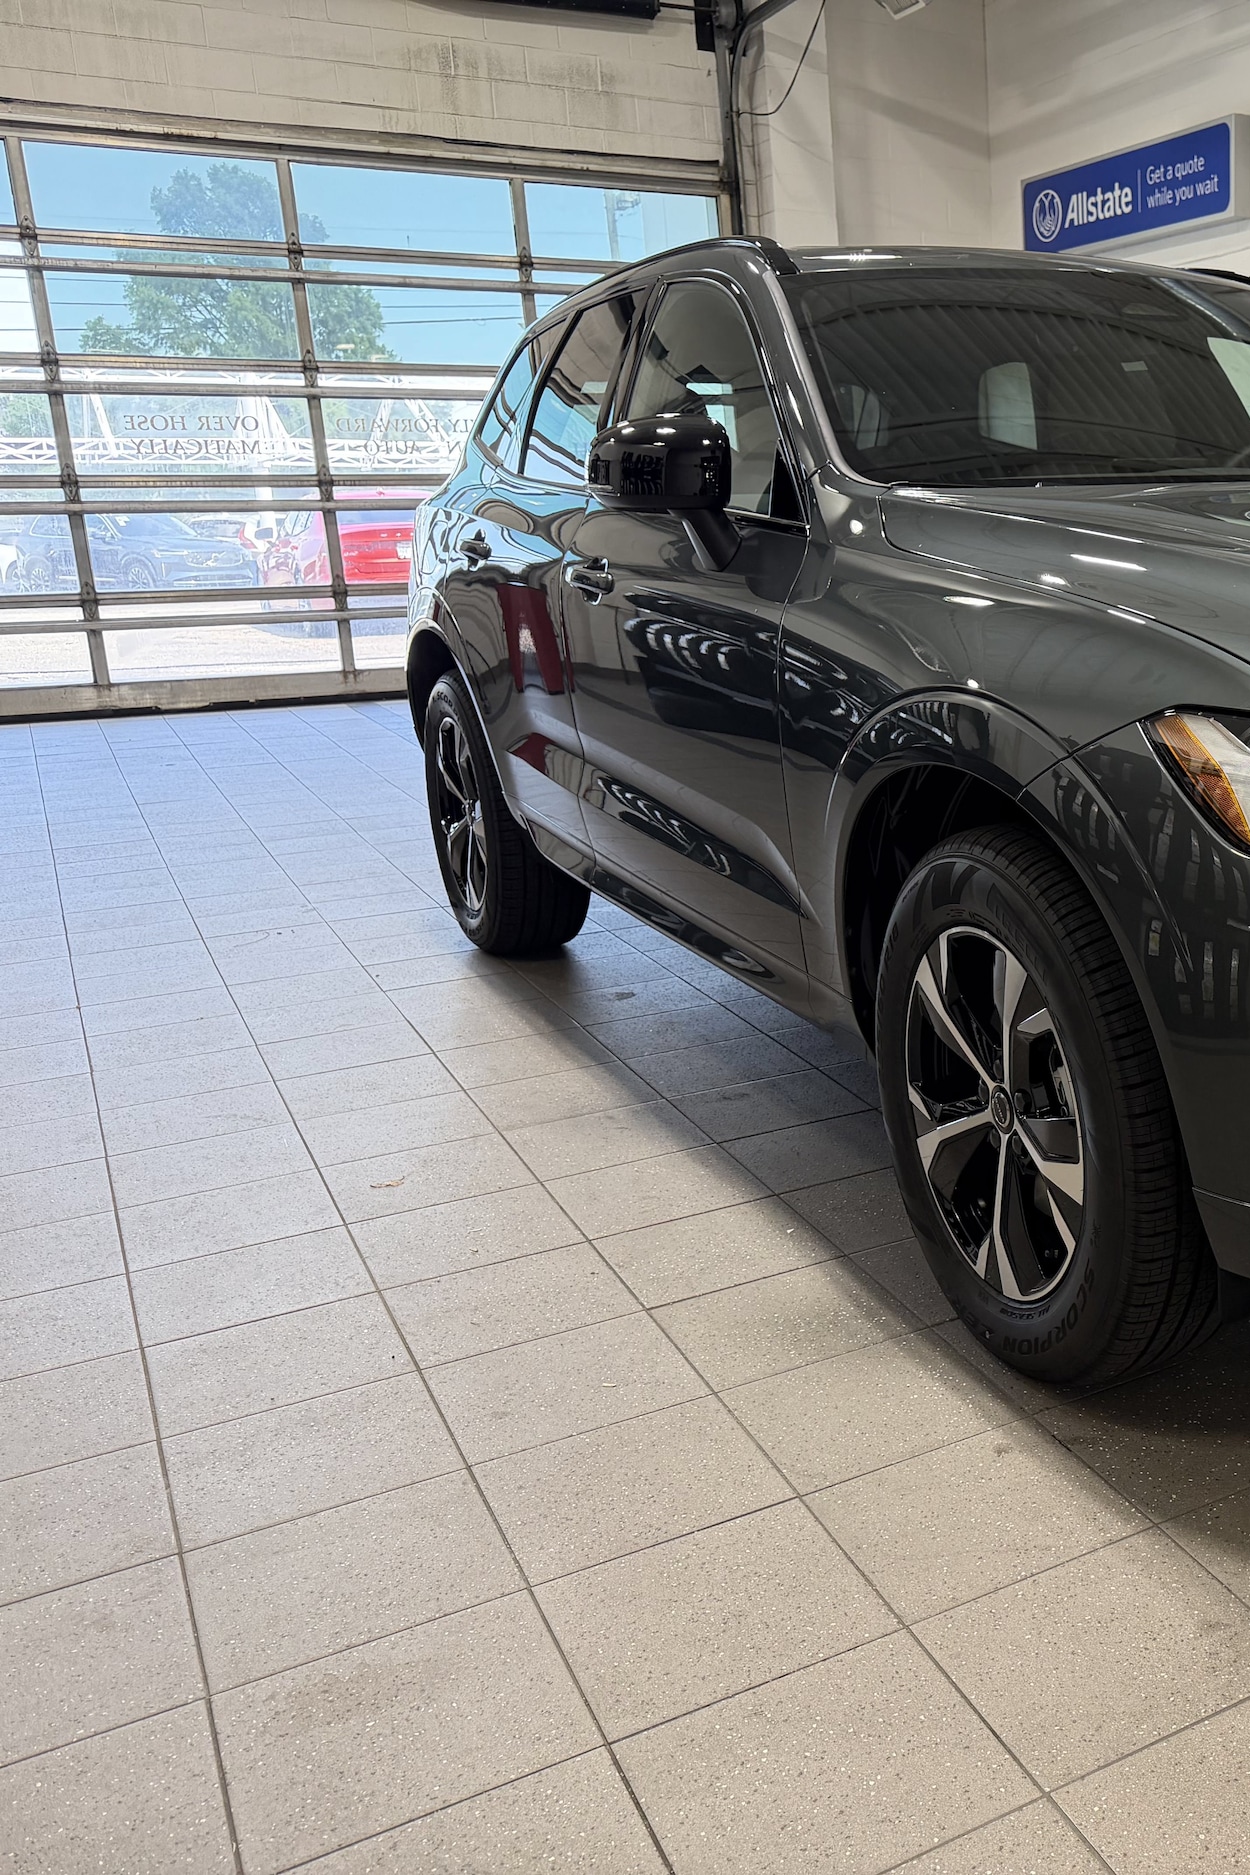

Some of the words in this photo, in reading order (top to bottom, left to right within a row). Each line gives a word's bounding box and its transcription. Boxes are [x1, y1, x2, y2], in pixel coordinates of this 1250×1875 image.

[1146, 163, 1165, 186] Get
[1166, 166, 1174, 180] a
[1174, 155, 1205, 181] quote
[1064, 181, 1133, 229] Allstate
[1146, 186, 1173, 209] while
[1174, 186, 1194, 206] you
[1195, 174, 1219, 195] wait
[1001, 1258, 1096, 1355] SCORPION
